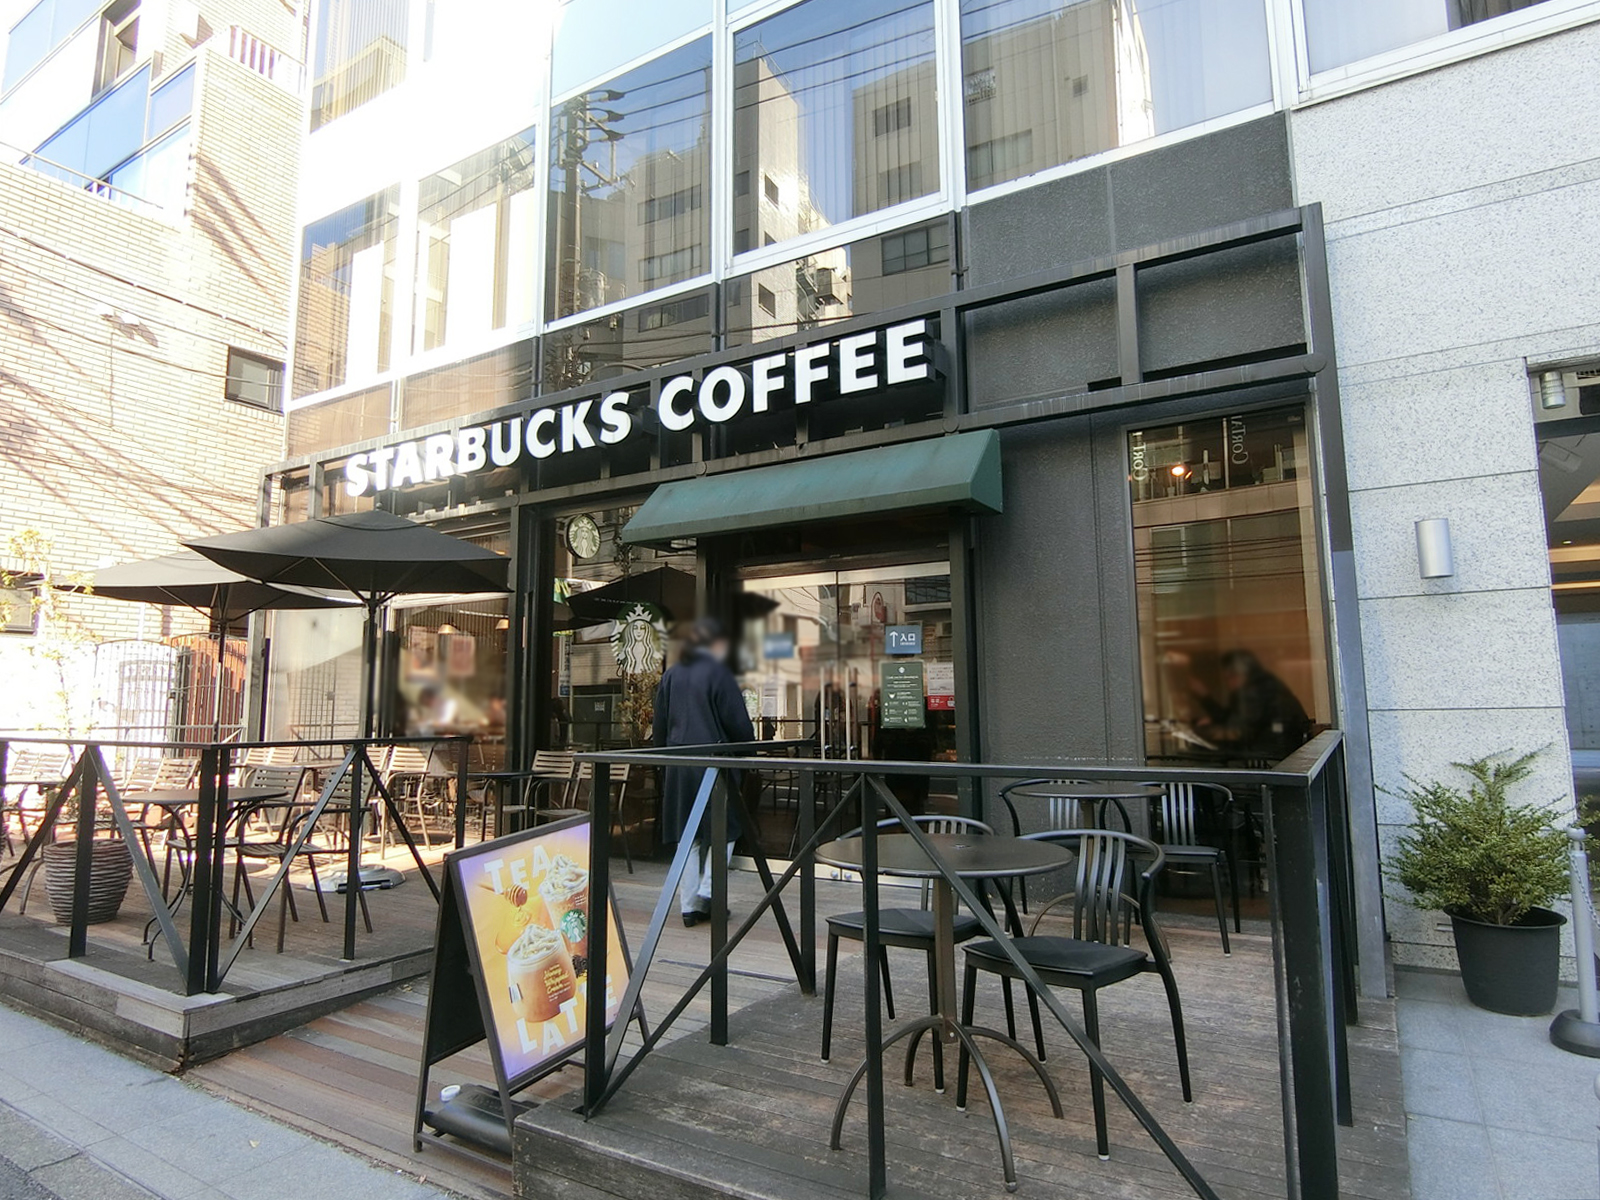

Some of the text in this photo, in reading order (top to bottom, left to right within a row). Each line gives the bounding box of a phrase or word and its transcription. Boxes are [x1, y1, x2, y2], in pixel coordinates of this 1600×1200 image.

[346, 320, 930, 497] STARBUCKS COFFEE
[900, 633, 916, 642] 入口
[484, 844, 552, 895] TEA
